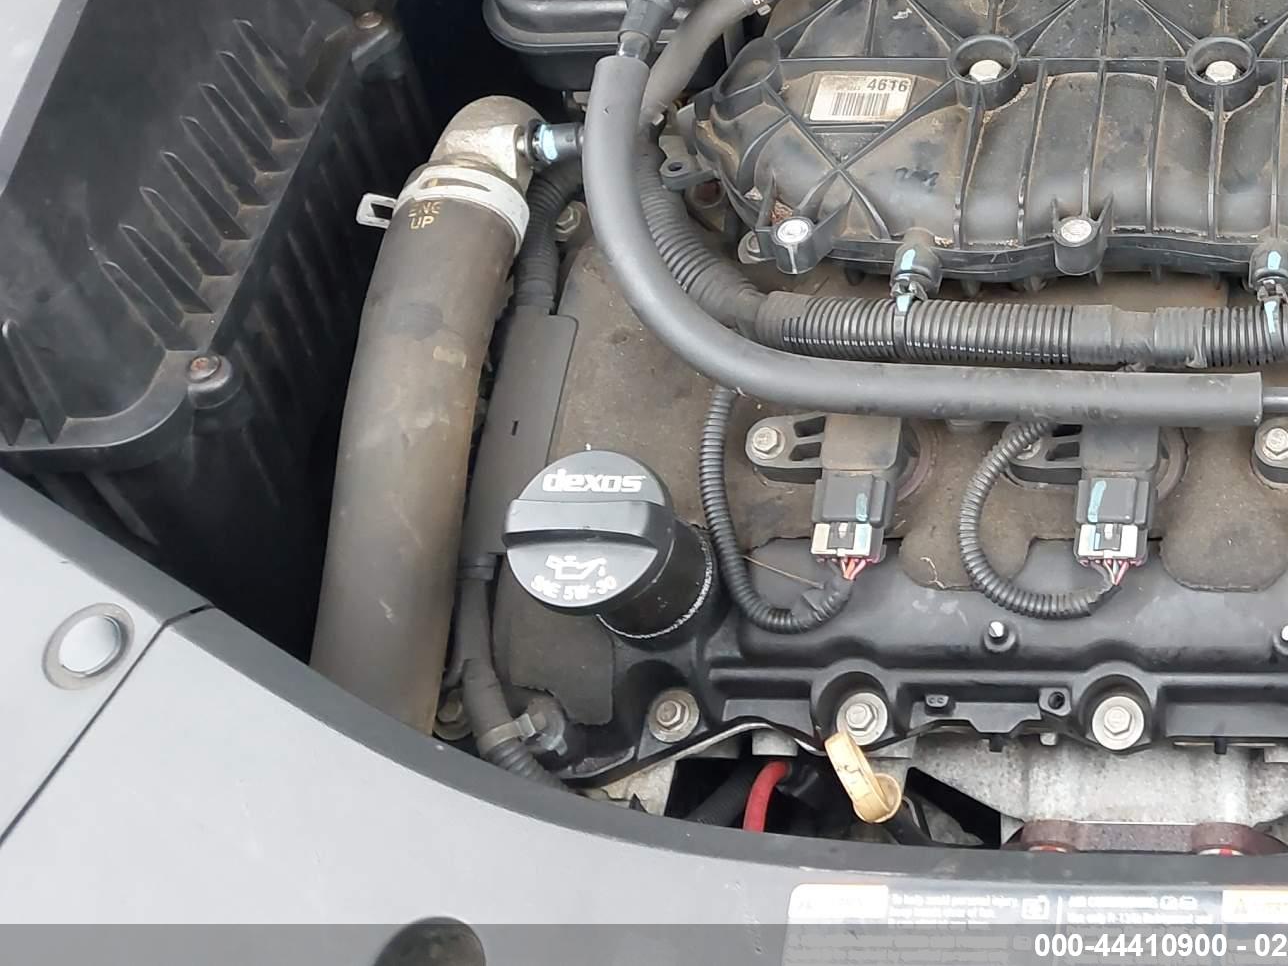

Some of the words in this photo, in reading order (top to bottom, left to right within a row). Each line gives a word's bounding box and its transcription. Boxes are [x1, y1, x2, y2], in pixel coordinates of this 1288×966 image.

[866, 78, 910, 92] 4616
[410, 215, 435, 230] UP
[542, 468, 646, 493] dexos
